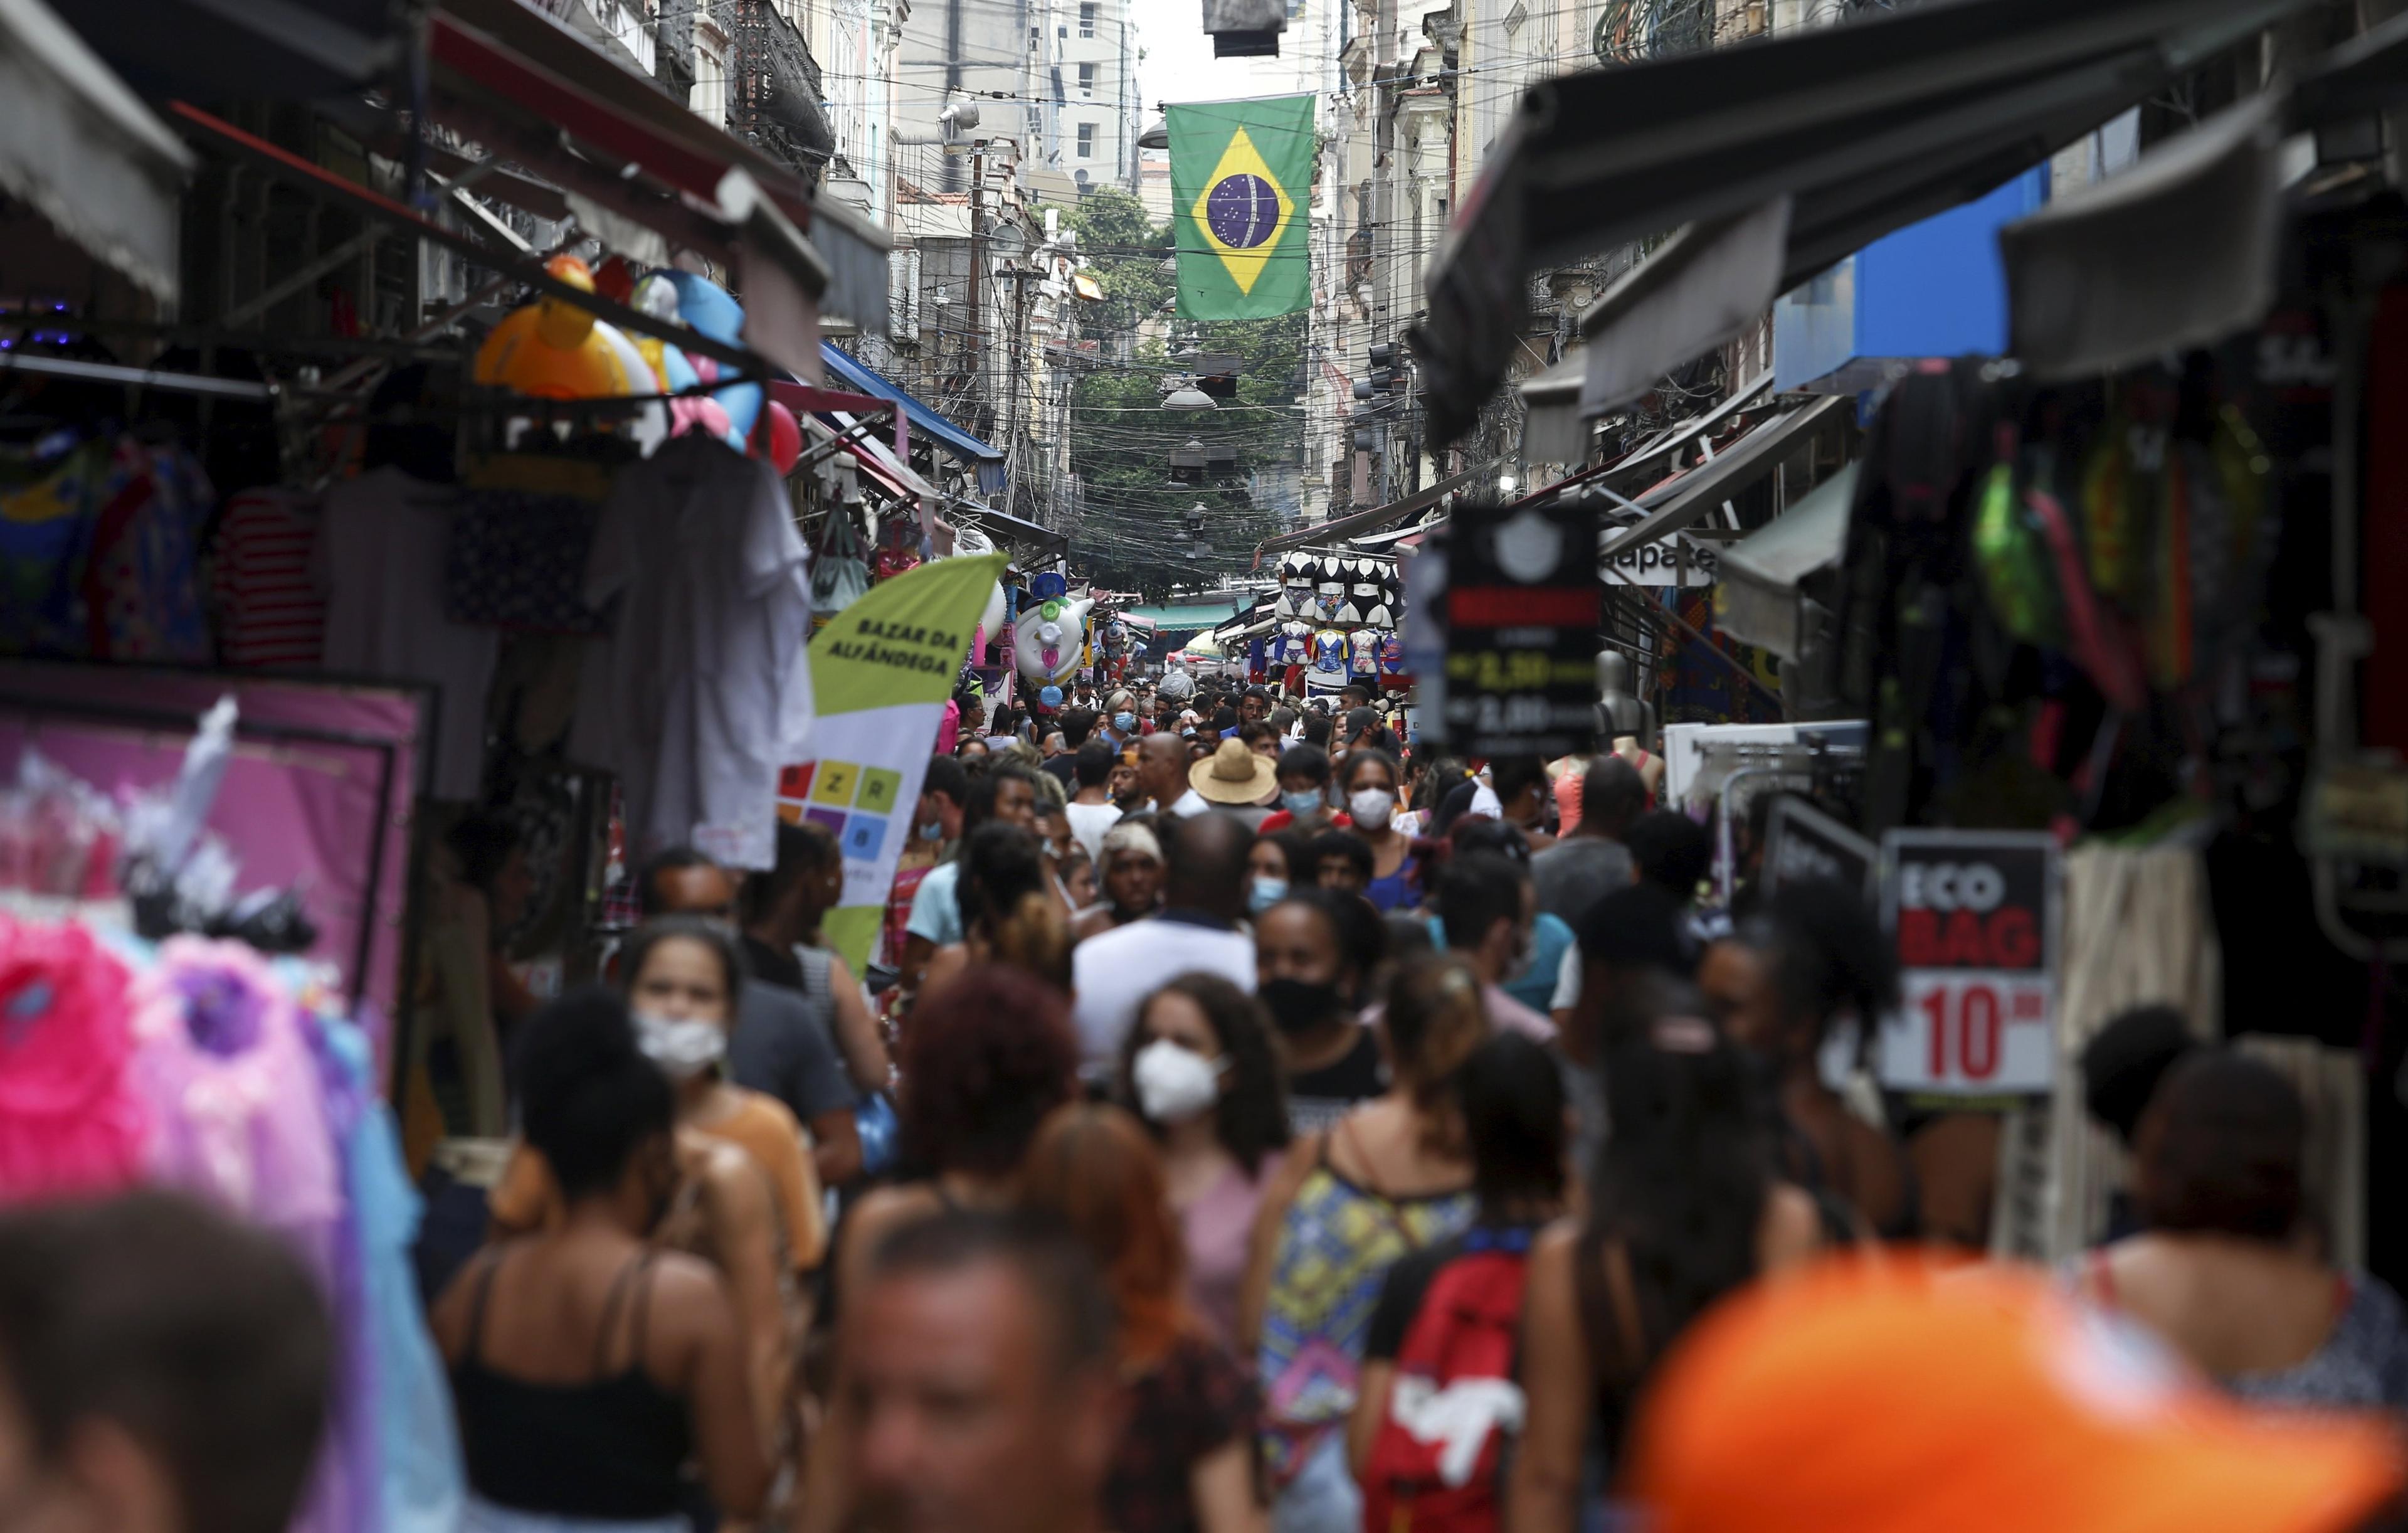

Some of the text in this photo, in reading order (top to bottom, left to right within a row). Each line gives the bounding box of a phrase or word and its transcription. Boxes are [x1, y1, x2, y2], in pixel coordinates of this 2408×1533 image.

[857, 618, 958, 651] BAZAR DA
[828, 640, 948, 676] ALFÂNDEGA
[1903, 865, 2005, 910] ECO
[1900, 906, 2039, 967] BAG
